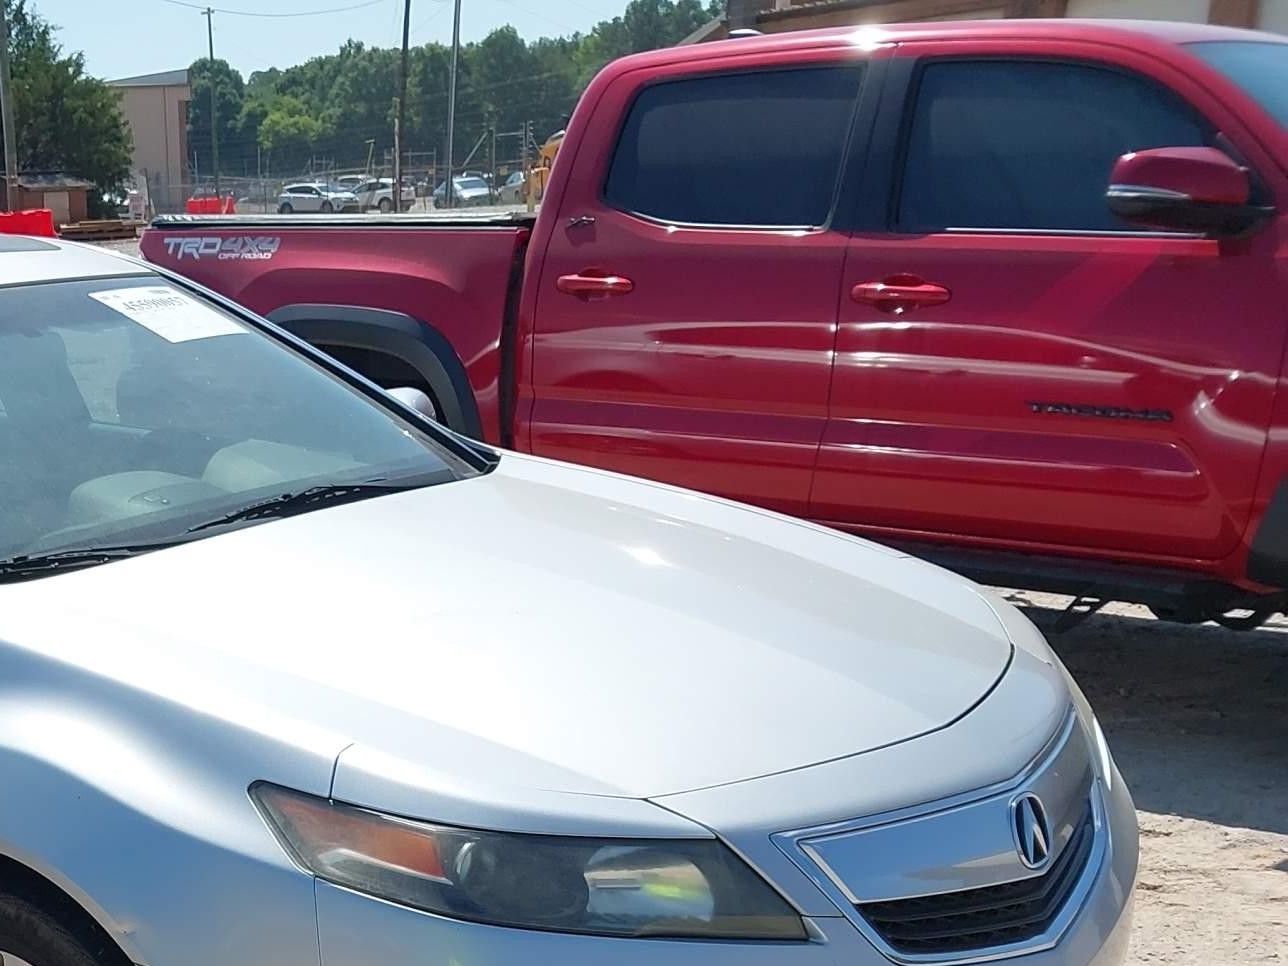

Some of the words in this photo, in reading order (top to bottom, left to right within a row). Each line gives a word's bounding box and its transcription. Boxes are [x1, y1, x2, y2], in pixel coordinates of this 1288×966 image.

[164, 237, 222, 260] TRD
[218, 252, 241, 260] OFF
[241, 252, 273, 260] ROAD
